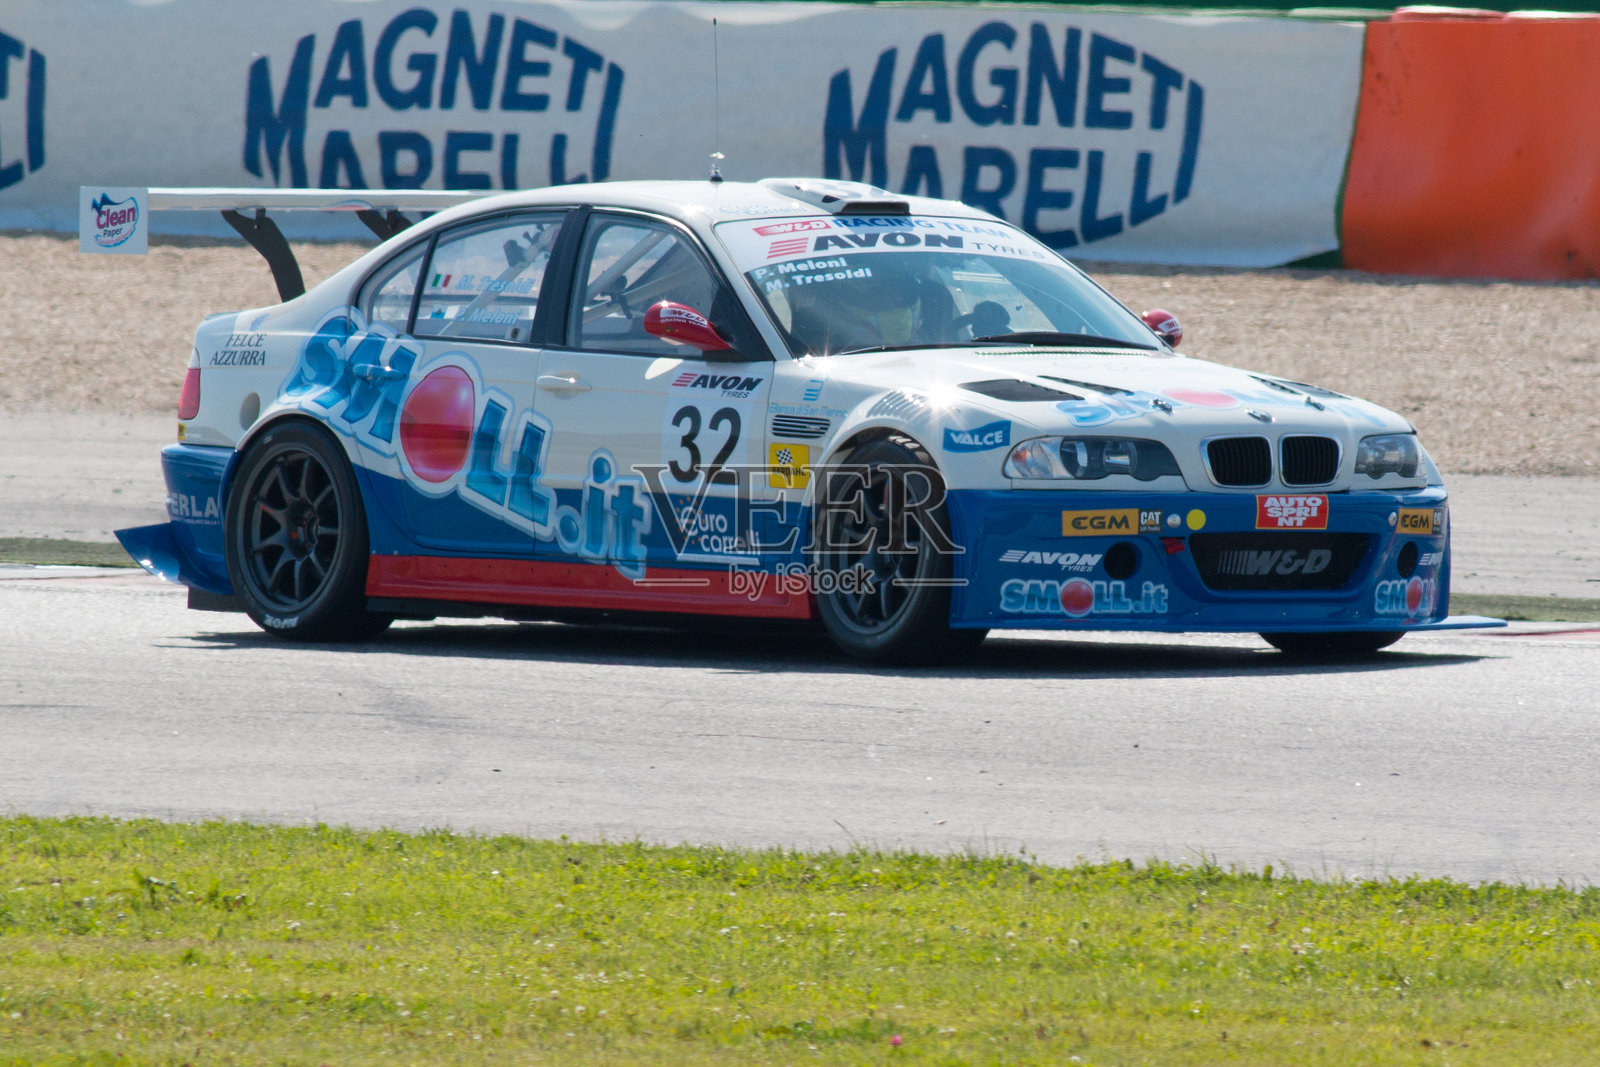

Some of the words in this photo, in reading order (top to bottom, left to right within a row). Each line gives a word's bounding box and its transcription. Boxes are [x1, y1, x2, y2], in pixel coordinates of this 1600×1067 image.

[244, 8, 625, 165] MAGNETI
[823, 21, 1205, 180] MAGNETI
[96, 206, 136, 229] Clean
[832, 216, 936, 230] RACING
[937, 220, 1013, 240] TEAM
[813, 231, 964, 252] AVON
[971, 242, 1046, 259] TYRES
[755, 267, 775, 280] P.
[777, 257, 848, 274] Meloni
[765, 278, 791, 293] M.
[791, 267, 872, 286] Tresoldi
[225, 333, 267, 347] FELCE
[208, 350, 266, 366] AZZURRA
[690, 374, 764, 391] AVON
[720, 390, 750, 399] TYRES
[803, 405, 820, 417] San
[668, 405, 741, 486] 32
[949, 430, 1004, 446] VALCE
[1263, 496, 1323, 508] AUTO
[1140, 511, 1162, 525] CAT
[1266, 506, 1318, 518] SPRI
[1071, 515, 1130, 530] CGM
[1277, 516, 1307, 527] NT
[1400, 514, 1430, 529] CGM
[1021, 551, 1103, 566] AVON
[1244, 549, 1333, 575] W&D
[1061, 564, 1094, 573] TYRES
